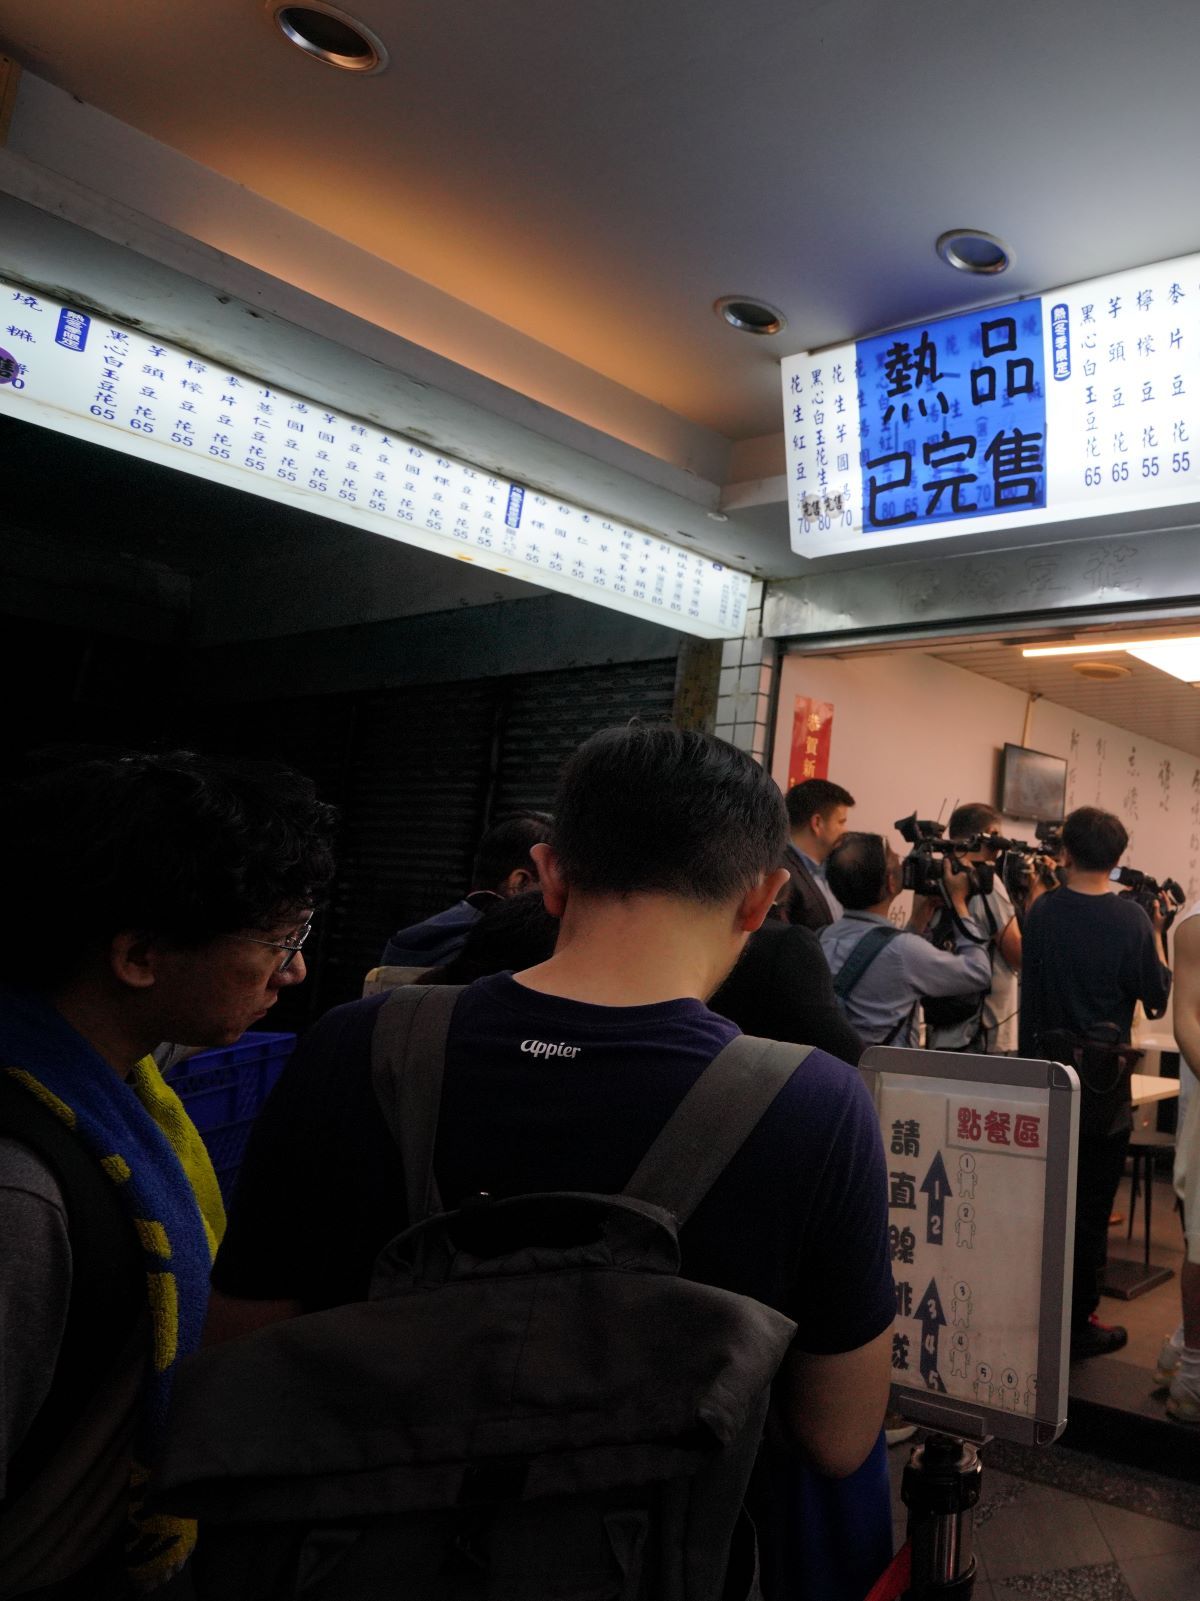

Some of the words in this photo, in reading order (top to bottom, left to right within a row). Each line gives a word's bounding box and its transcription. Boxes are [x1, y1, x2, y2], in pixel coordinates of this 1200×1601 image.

[884, 317, 1034, 424] 熱品
[90, 405, 116, 421] 65
[130, 418, 154, 433] 65
[171, 432, 194, 447] 55
[208, 445, 231, 459] 55
[244, 457, 265, 471] 55
[1142, 457, 1159, 477] 55
[1173, 451, 1190, 473] 55
[277, 468, 297, 481] 55
[866, 428, 1044, 527] 已完售
[1085, 466, 1101, 486] 65
[1112, 462, 1128, 482] 65
[308, 479, 328, 492] 55
[338, 489, 356, 502] 55
[369, 499, 386, 512] 55
[396, 509, 414, 521] 55
[840, 510, 853, 527] 70
[425, 519, 442, 531] 55
[452, 528, 468, 540] 55
[476, 536, 492, 548] 55
[957, 1107, 1041, 1149] 點餐區
[931, 1215, 942, 1235] 2
[928, 1299, 937, 1320] 3
[925, 1333, 936, 1354] 4
[929, 1370, 939, 1391] 5
